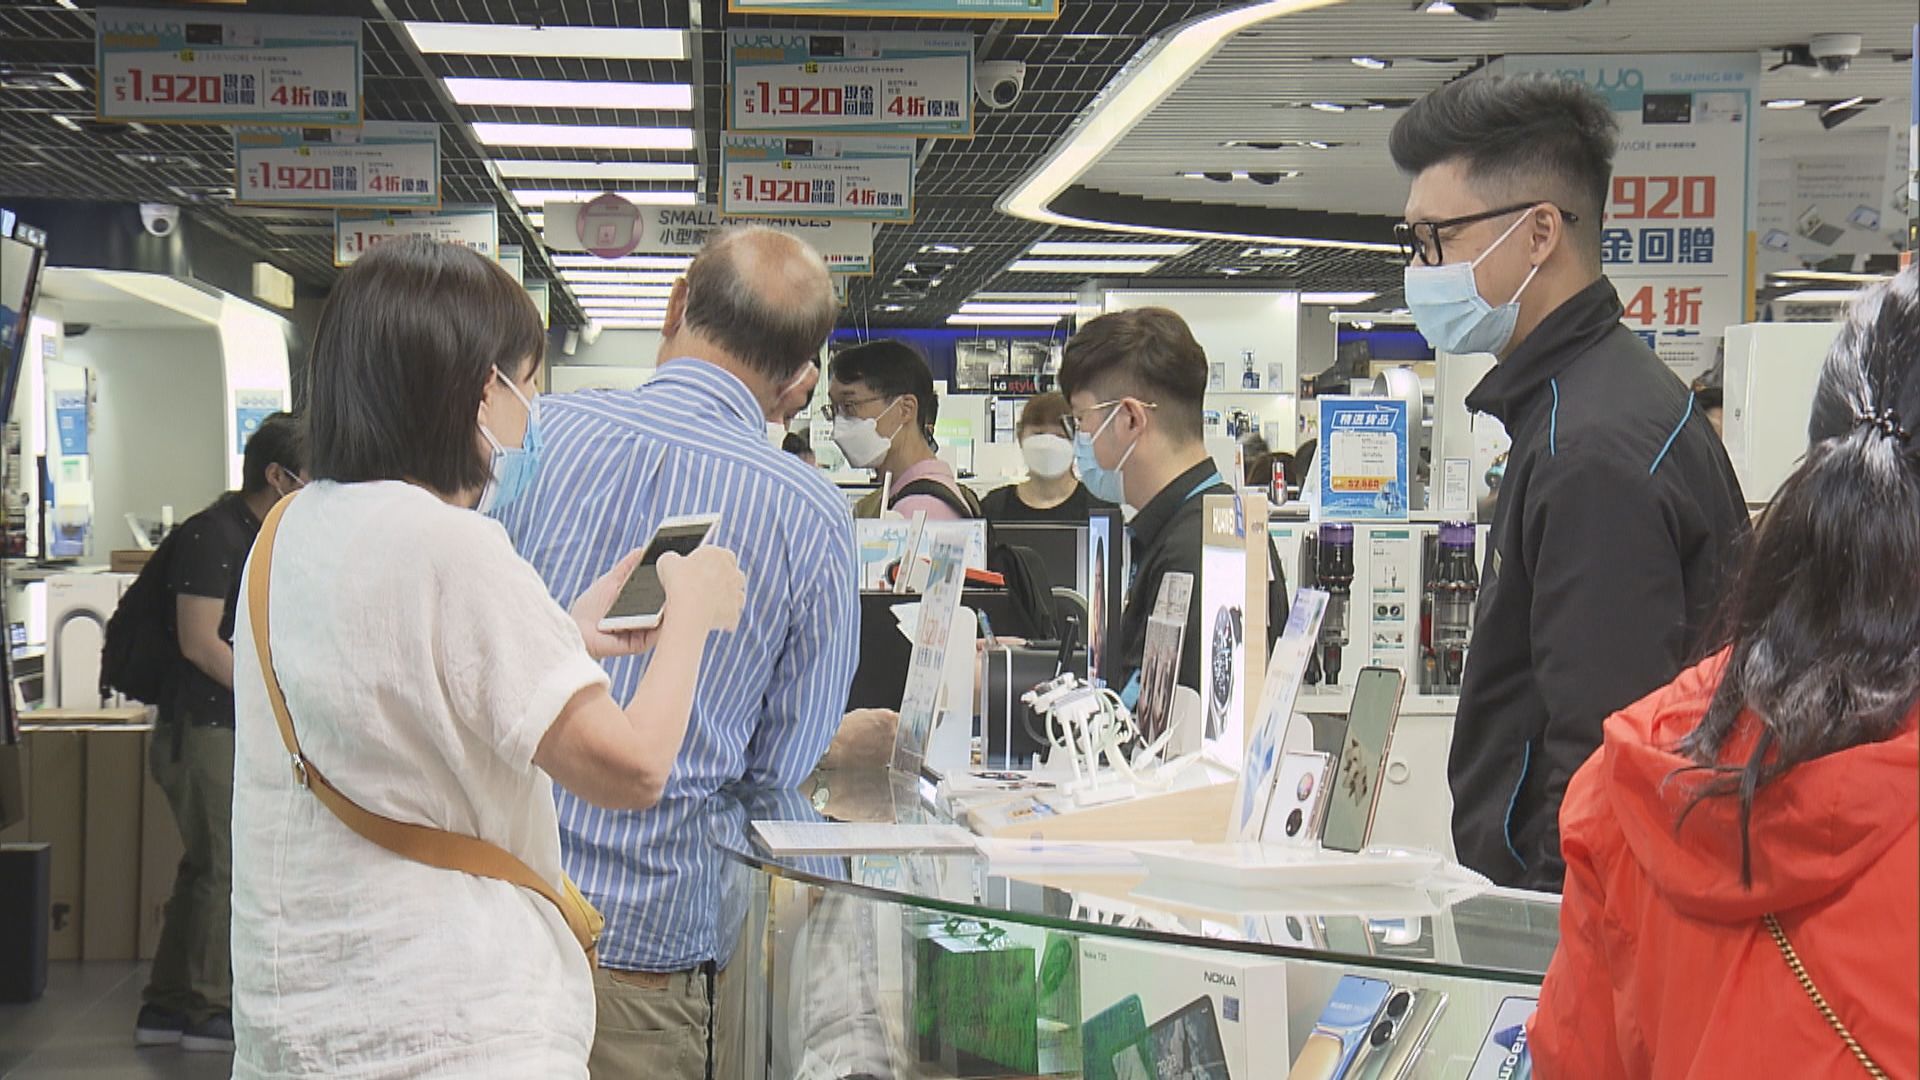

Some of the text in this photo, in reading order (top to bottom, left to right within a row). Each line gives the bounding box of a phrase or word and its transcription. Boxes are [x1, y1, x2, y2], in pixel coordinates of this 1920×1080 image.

[745, 82, 842, 115] $1,920
[659, 209, 717, 225] SMALL
[1623, 286, 1703, 325] 4折
[1204, 971, 1236, 987] NOKIA
